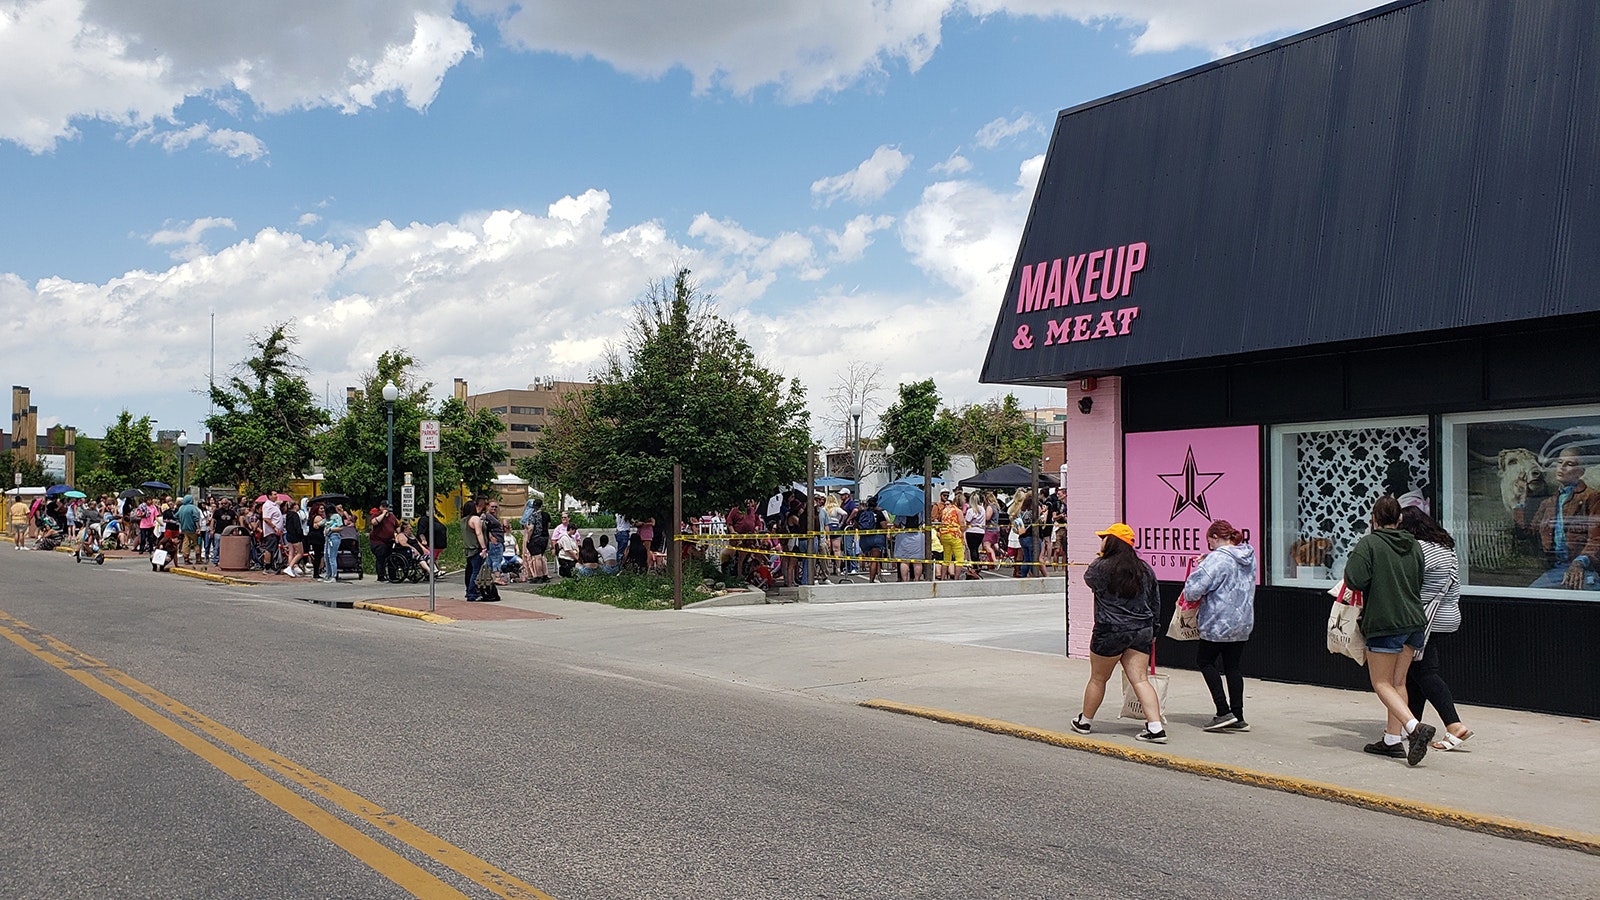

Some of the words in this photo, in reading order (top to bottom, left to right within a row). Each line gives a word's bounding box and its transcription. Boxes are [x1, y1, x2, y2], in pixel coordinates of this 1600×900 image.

[1016, 241, 1147, 314] MAKEUP
[1012, 324, 1034, 350] &
[1044, 306, 1139, 346] MEAT
[1135, 528, 1200, 551] JEFFREE
[1151, 555, 1196, 568] COSME
